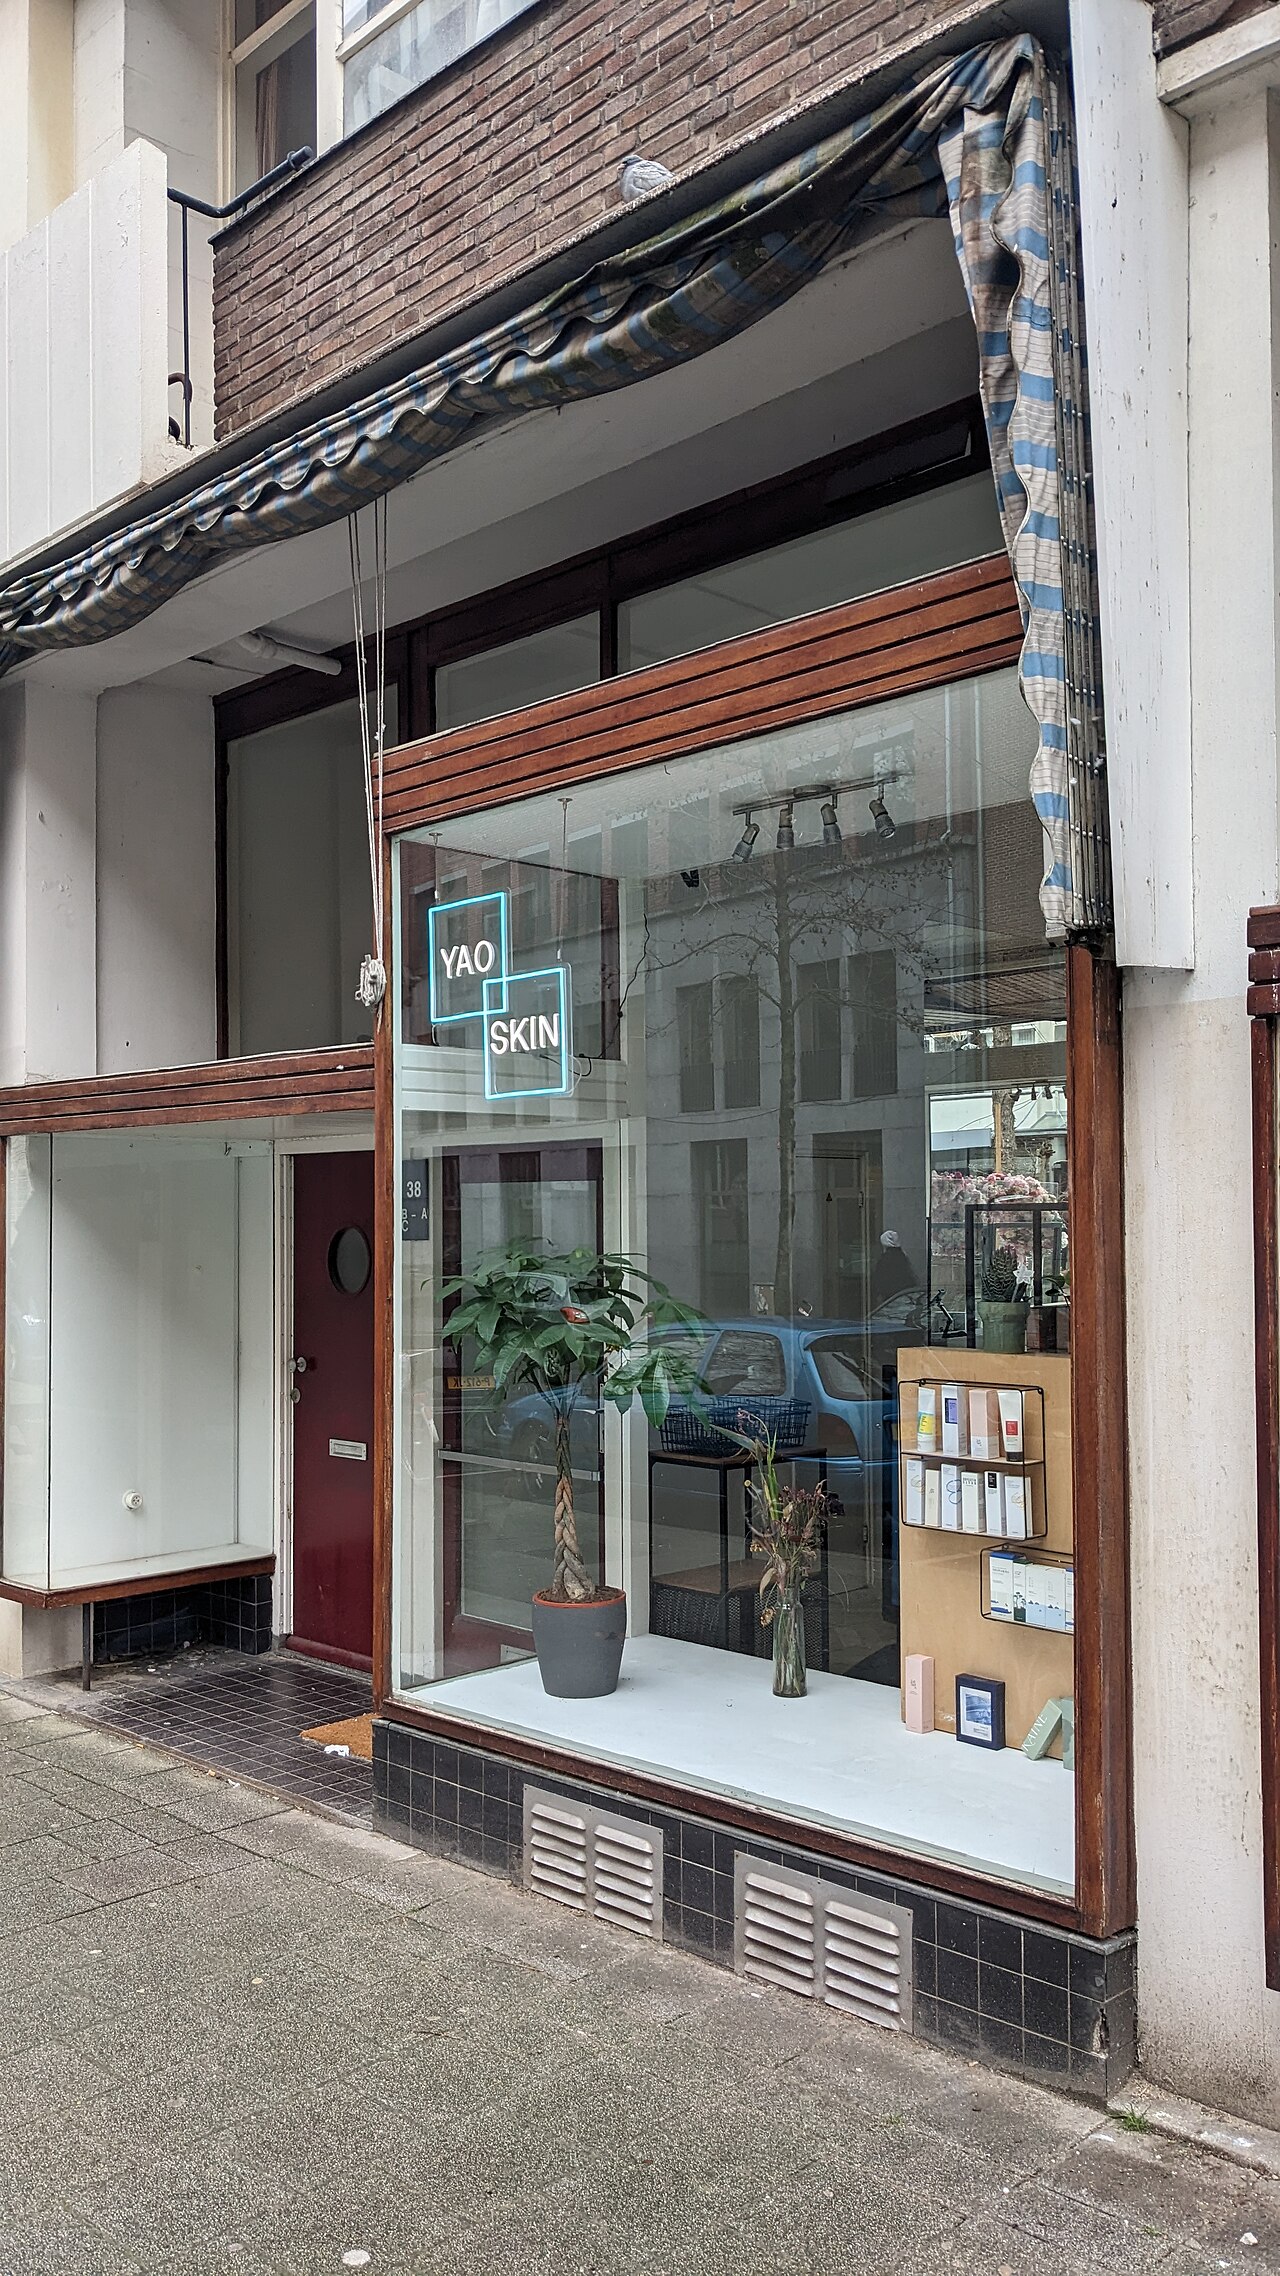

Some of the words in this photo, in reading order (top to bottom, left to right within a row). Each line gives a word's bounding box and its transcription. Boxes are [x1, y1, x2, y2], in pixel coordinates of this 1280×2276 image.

[440, 939, 495, 979] YAO
[490, 1013, 560, 1055] SKIN
[406, 1181, 422, 1198] 38
[421, 1207, 428, 1220] A
[1021, 1714, 1048, 1752] KAINE
